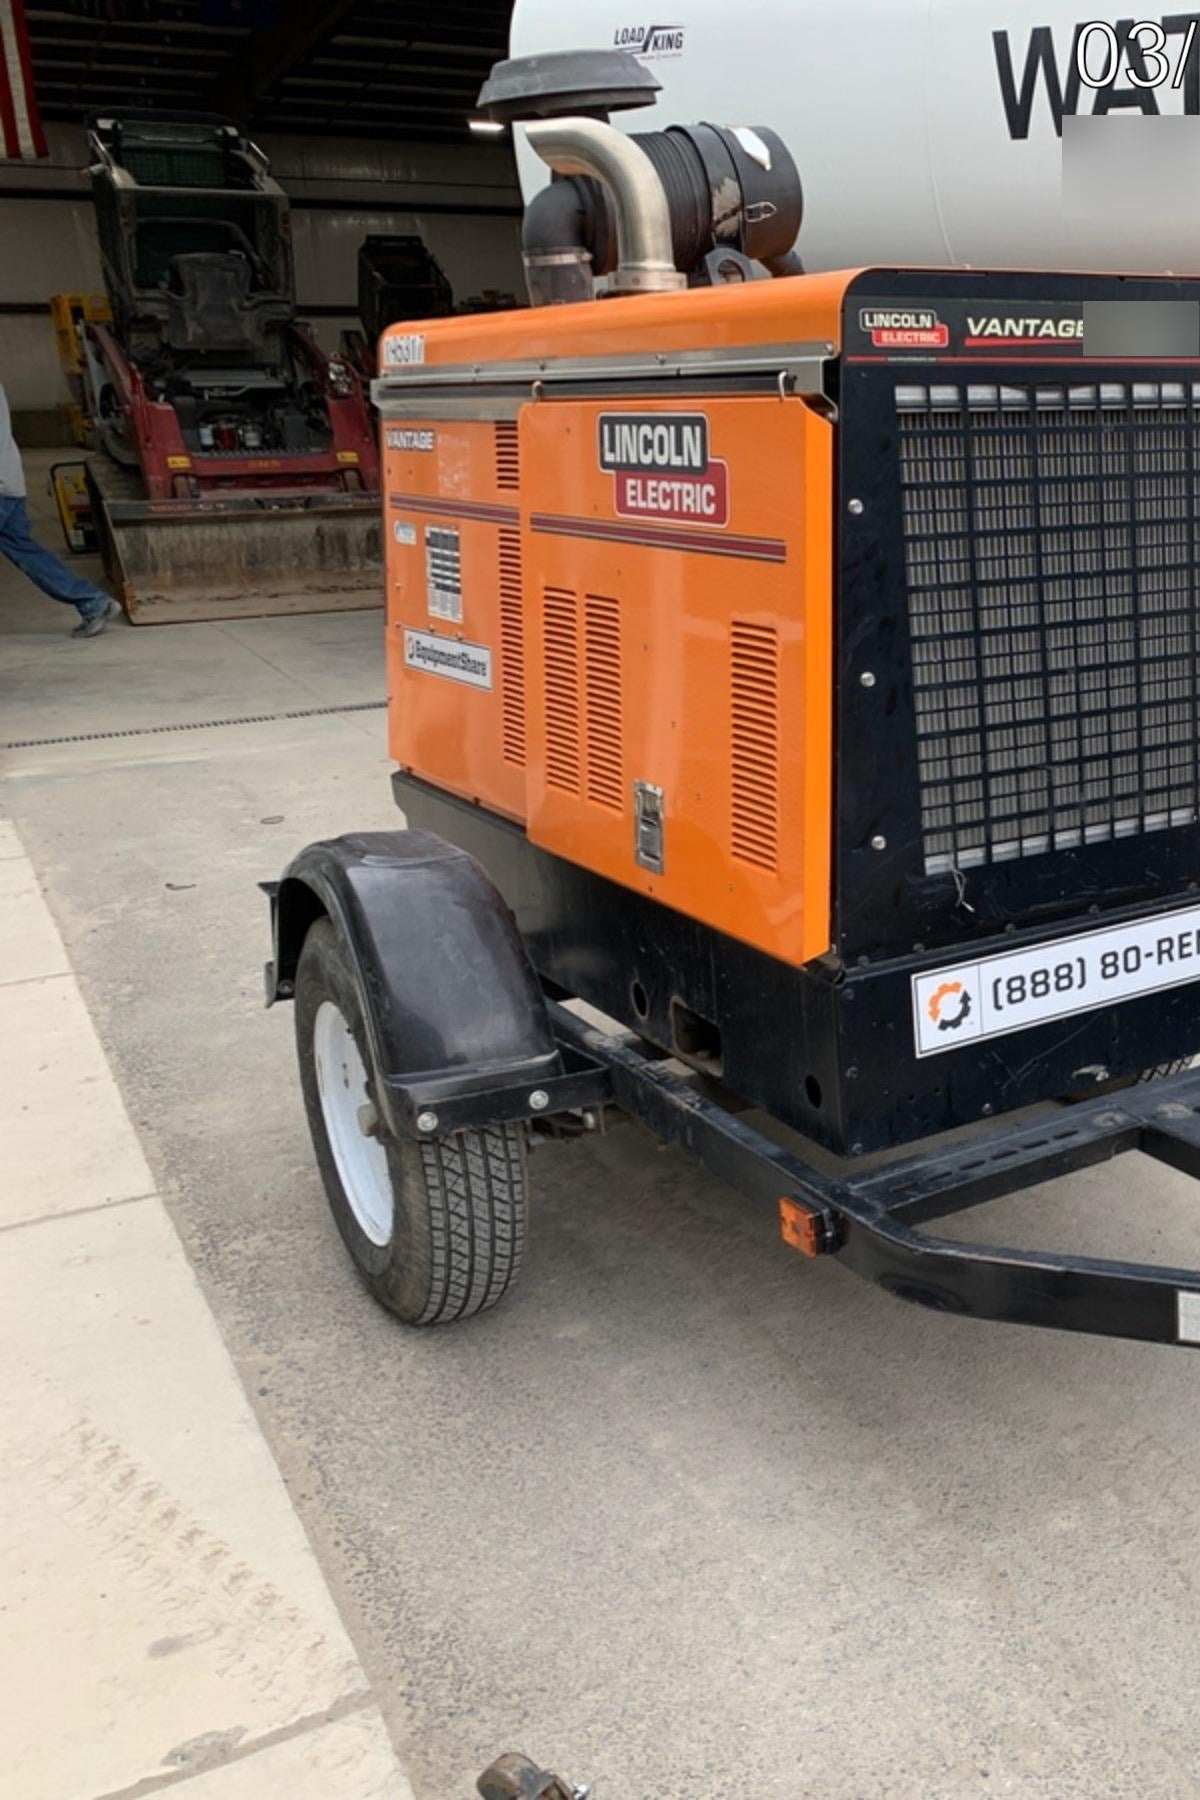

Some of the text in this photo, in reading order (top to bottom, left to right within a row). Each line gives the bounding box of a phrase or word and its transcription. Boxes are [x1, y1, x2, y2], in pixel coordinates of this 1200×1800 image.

[614, 27, 684, 51] LOAD KING
[864, 312, 932, 328] LINCOLN
[880, 331, 941, 344] ELECTRIC
[388, 430, 434, 450] VANTAGE
[603, 423, 702, 468] LINCOLN
[625, 477, 716, 516] ELECTRIC
[992, 957, 1087, 1011] (888)
